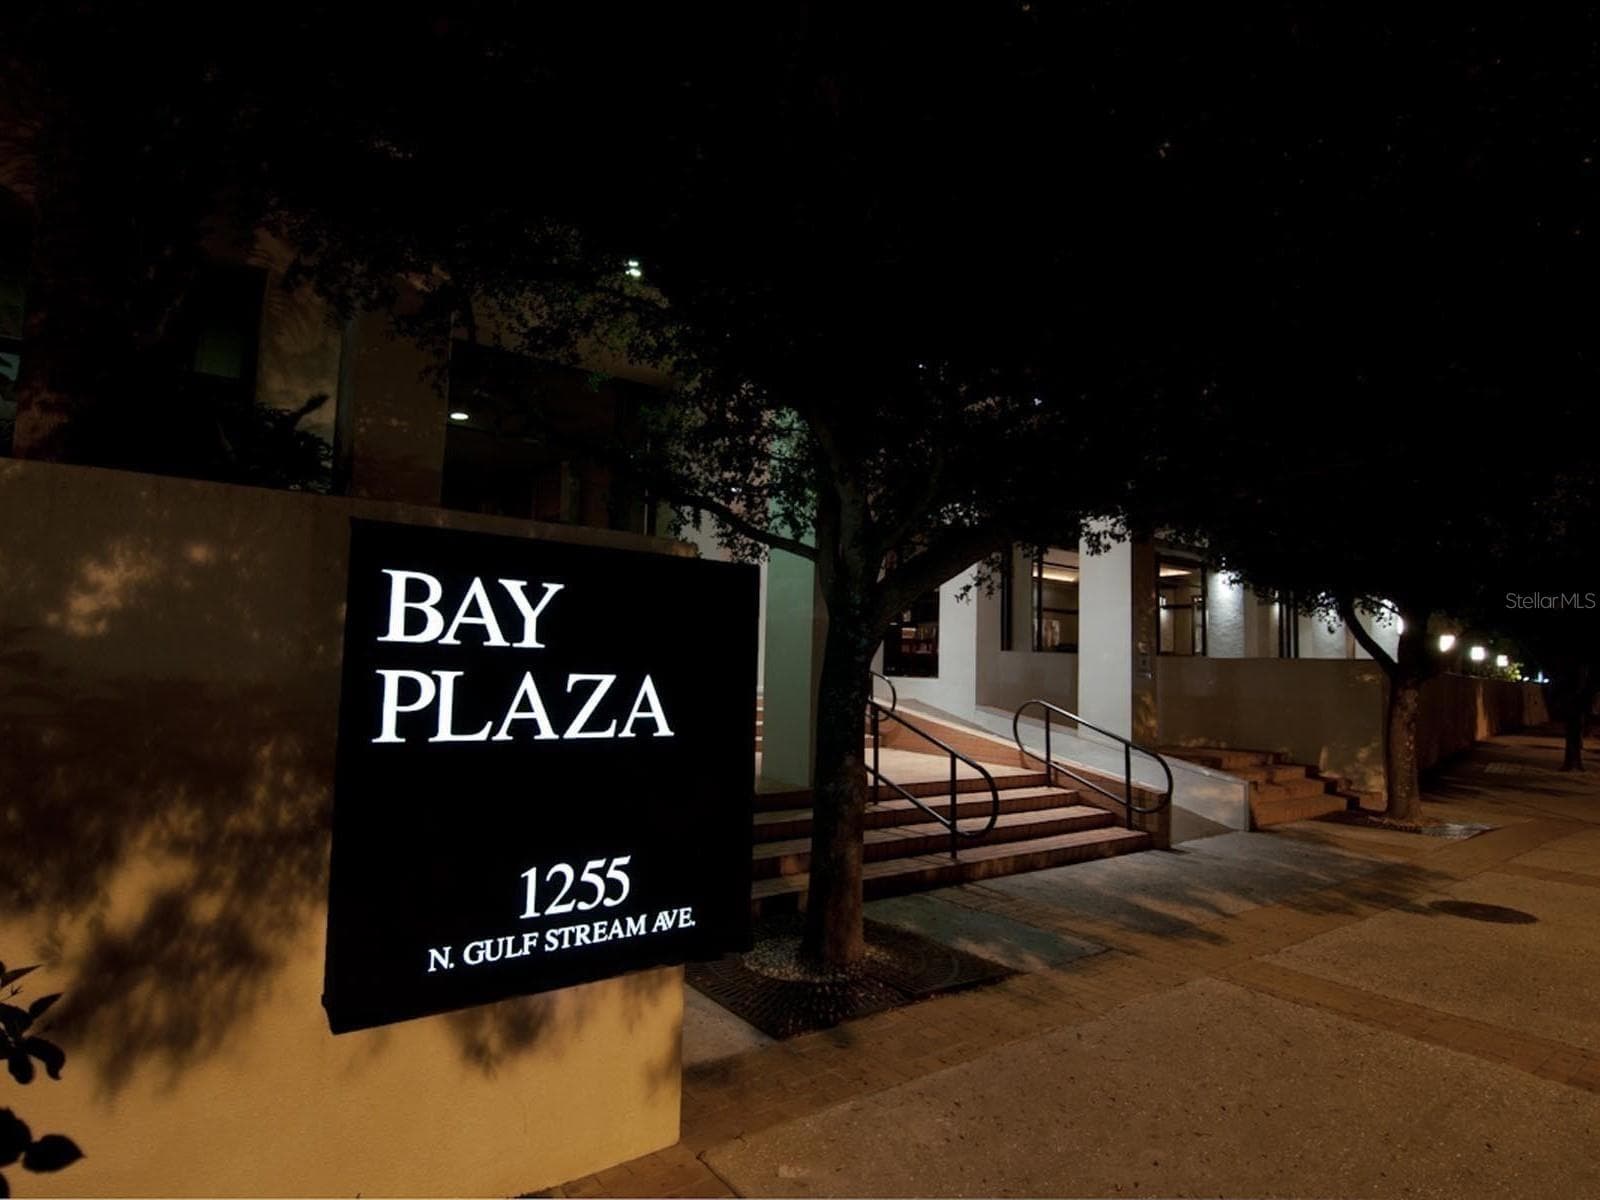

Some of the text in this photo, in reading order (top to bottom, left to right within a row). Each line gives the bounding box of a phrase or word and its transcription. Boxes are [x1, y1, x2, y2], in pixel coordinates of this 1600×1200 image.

[376, 568, 565, 649] BAY
[371, 669, 675, 743] PLAZA
[519, 855, 632, 919] 1255
[427, 906, 697, 973] N. GULF STREAM AVE.
